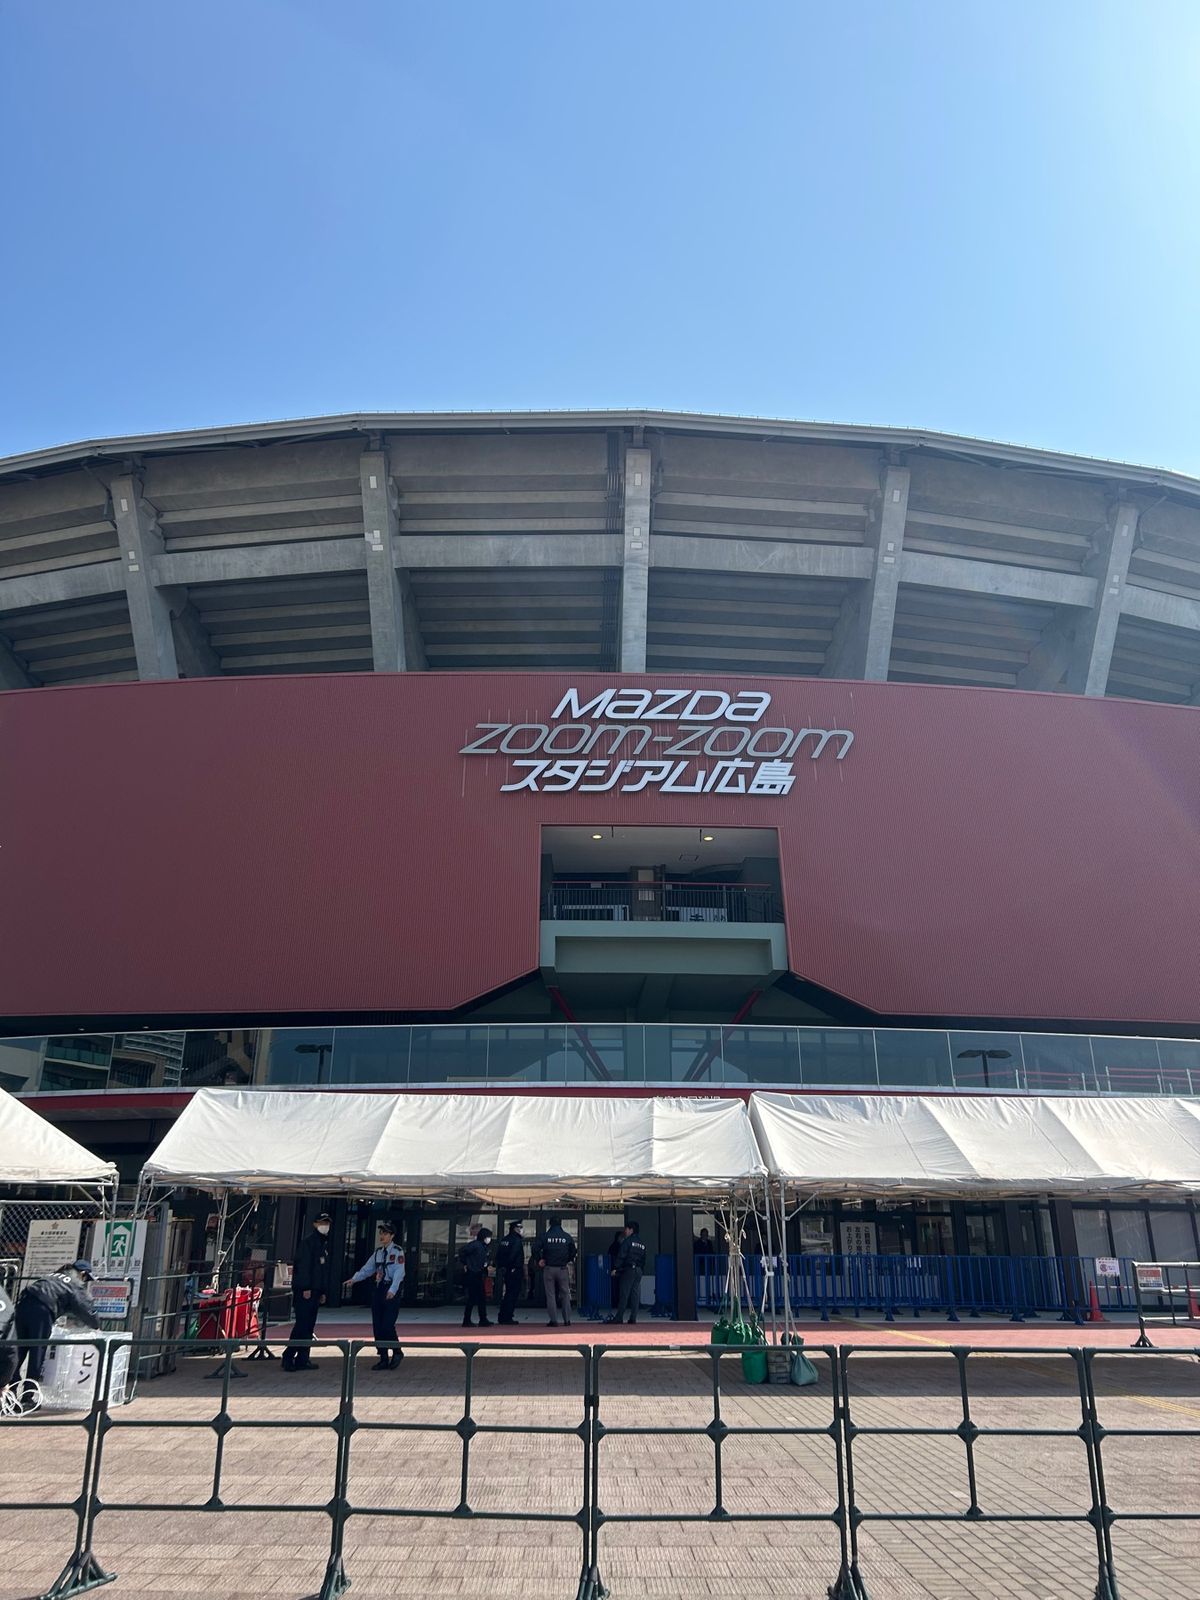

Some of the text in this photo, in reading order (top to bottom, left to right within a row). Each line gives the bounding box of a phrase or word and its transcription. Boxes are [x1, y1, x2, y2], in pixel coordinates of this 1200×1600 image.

[500, 758, 796, 794] スタジアム広島
